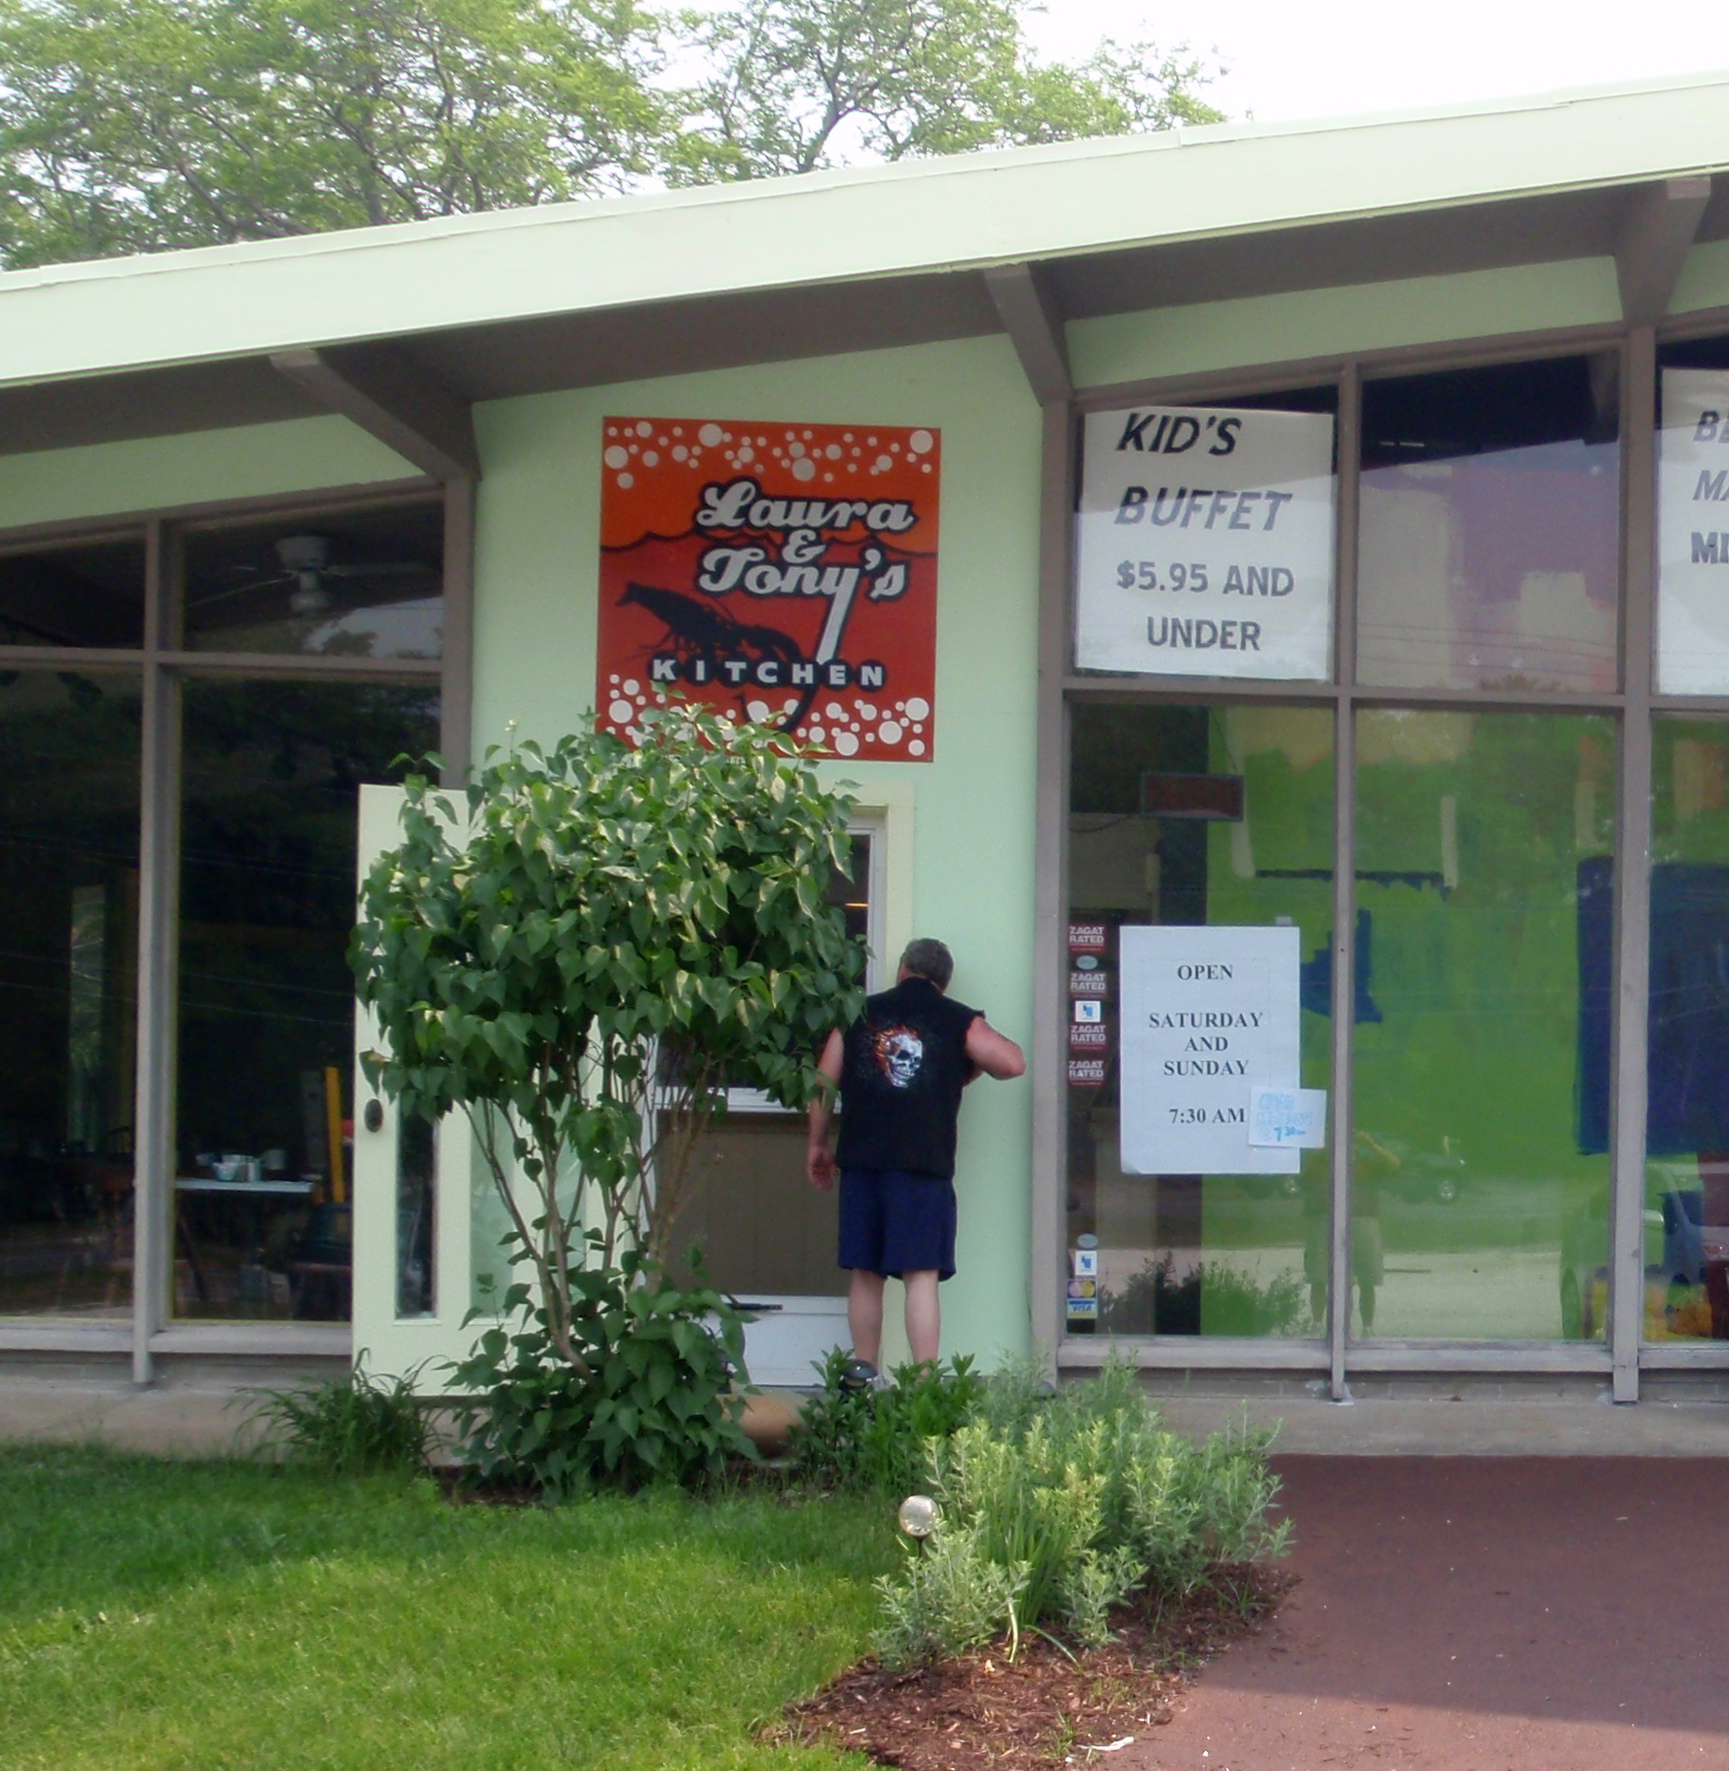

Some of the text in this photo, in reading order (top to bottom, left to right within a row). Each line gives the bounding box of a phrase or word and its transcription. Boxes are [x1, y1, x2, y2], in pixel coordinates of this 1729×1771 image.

[1116, 413, 1243, 456] KID'S
[695, 480, 917, 531] Laura
[1114, 486, 1294, 531] BUFFET
[780, 528, 828, 564] &
[1116, 559, 1295, 597] $5.95 AND
[699, 546, 908, 666] Tony's
[1146, 616, 1261, 652] UNDER
[652, 658, 884, 688] KITCHEN
[1069, 926, 1105, 935] ZAGAT
[1069, 935, 1105, 944] RATED
[1070, 973, 1106, 982] ZAGAT
[1177, 964, 1234, 980] OPEN
[1070, 982, 1106, 991] RATED
[1149, 1012, 1263, 1028] SATURDAY
[1070, 1025, 1106, 1033] ZAGAT
[1070, 1033, 1106, 1042] RATED
[1185, 1036, 1229, 1052] AND
[1068, 1060, 1104, 1069] ZAGAT
[1163, 1060, 1249, 1076] SUNDAY
[1068, 1069, 1104, 1078] RATED
[1168, 1108, 1206, 1123] 7:30
[1212, 1108, 1246, 1123] AM
